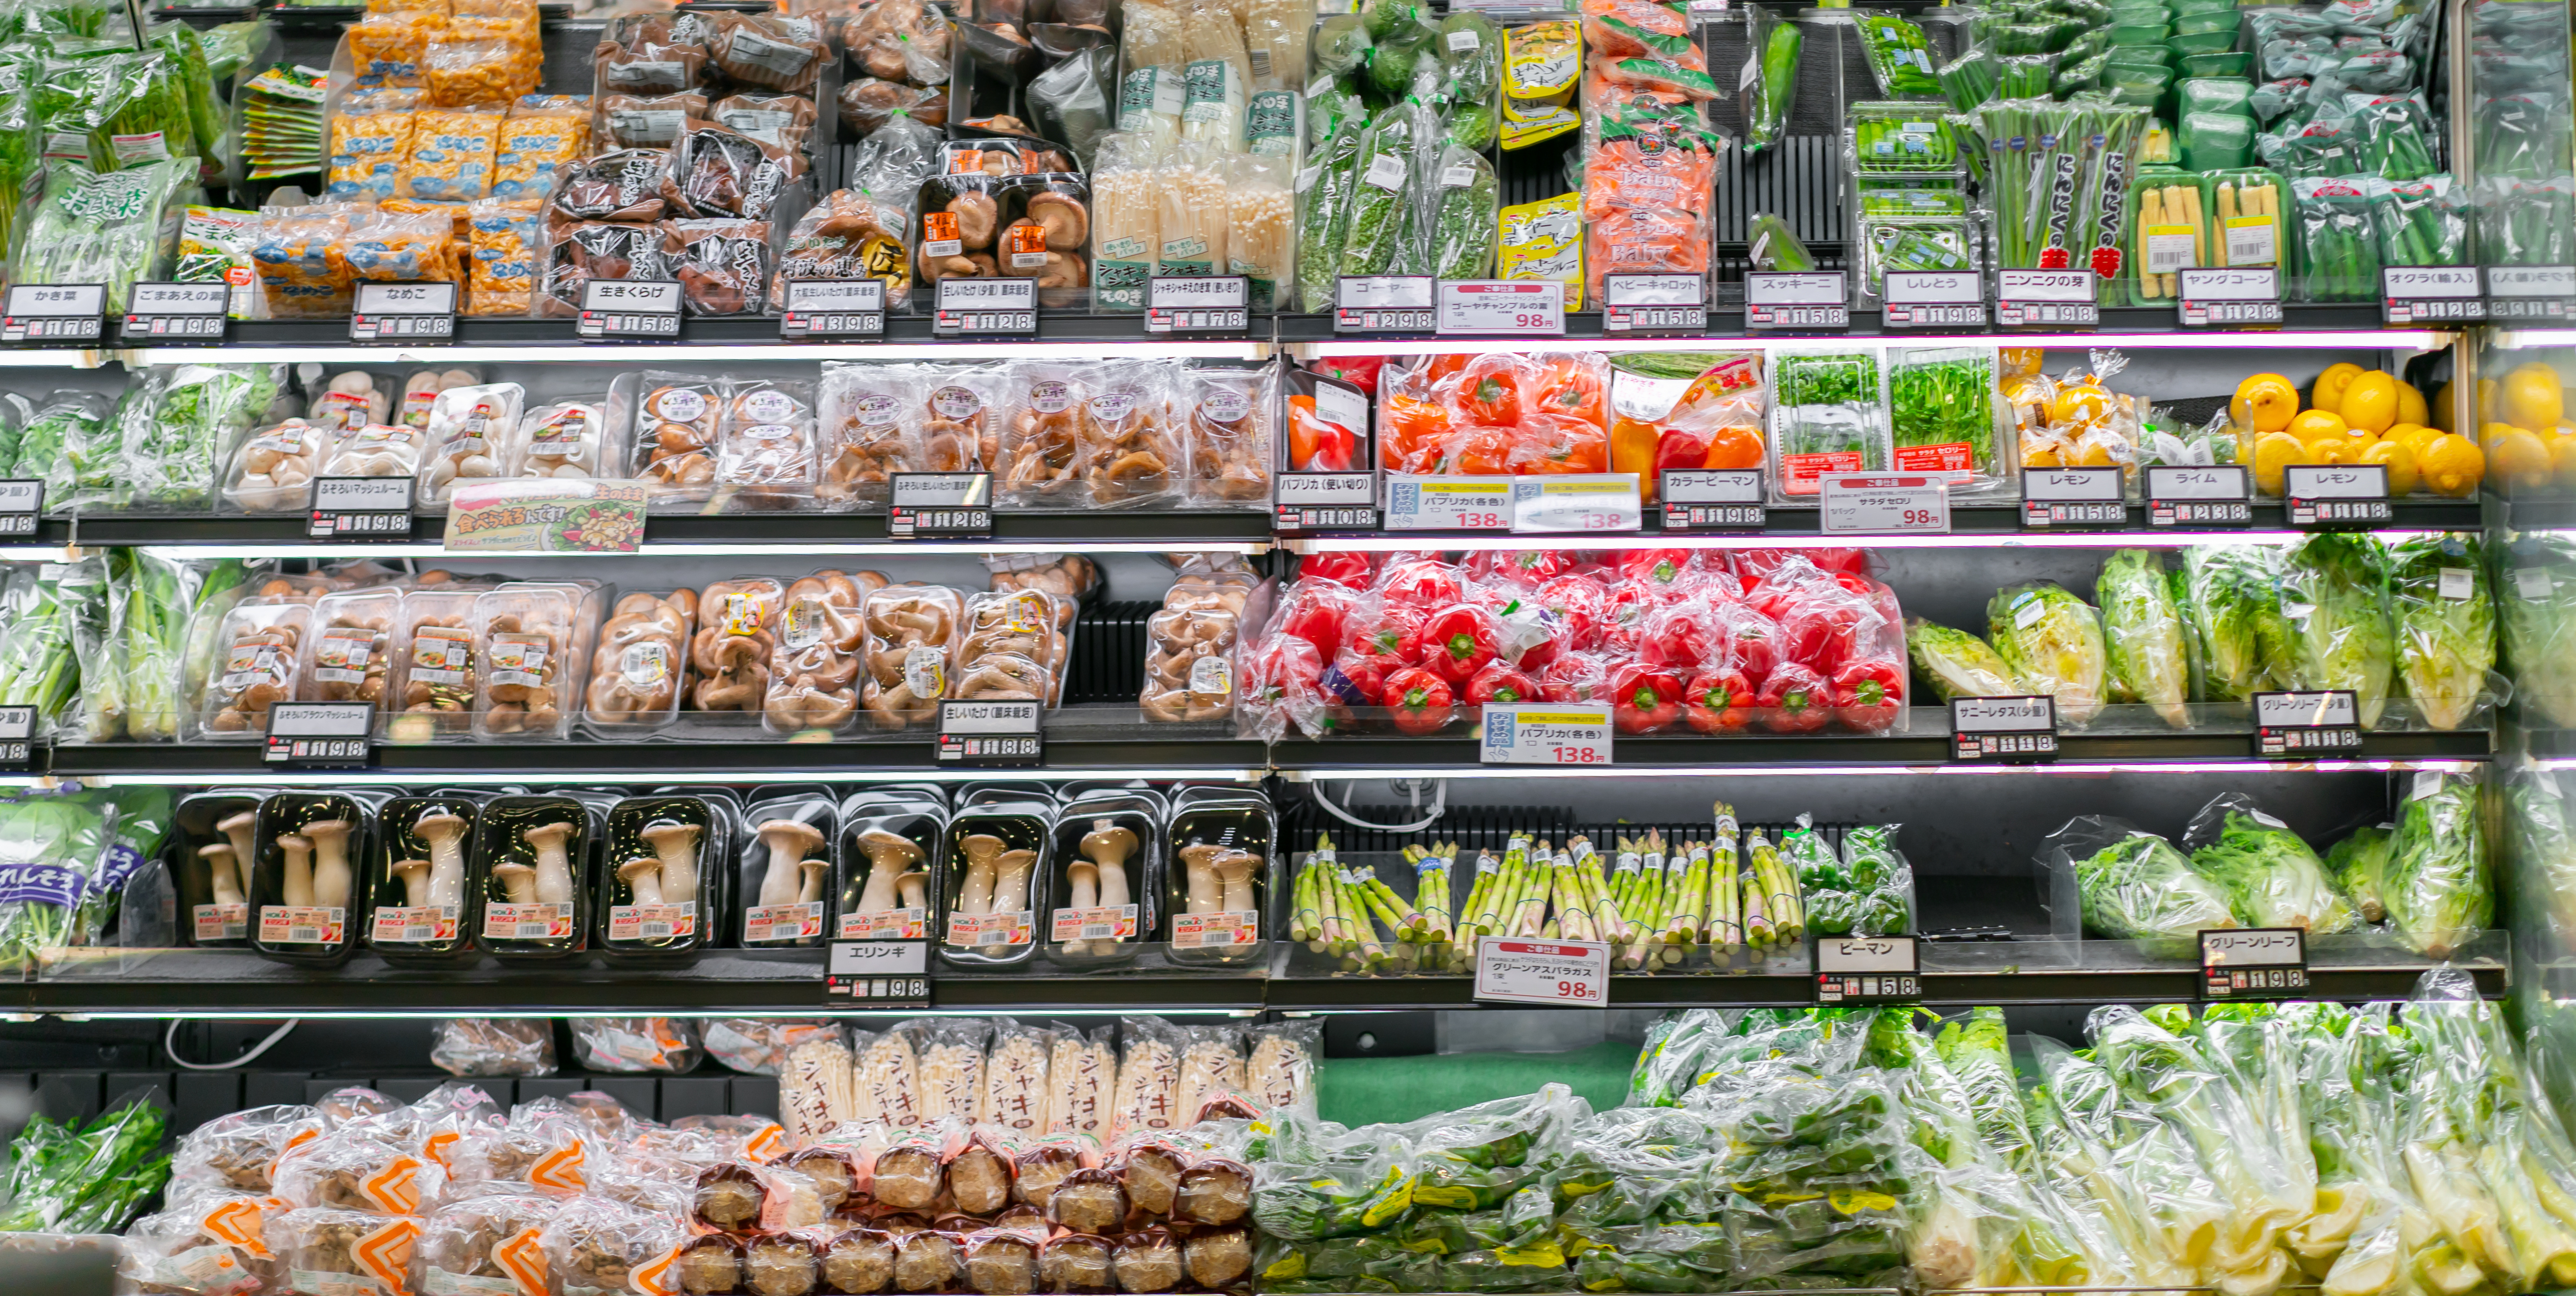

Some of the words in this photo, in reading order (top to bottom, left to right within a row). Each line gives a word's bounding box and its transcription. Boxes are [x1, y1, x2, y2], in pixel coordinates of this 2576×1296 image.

[1622, 171, 1683, 191] Baby
[1598, 223, 1686, 237] ベビーキャロット
[1609, 242, 1672, 266] Baby
[1613, 279, 1697, 290] ベビーキャロット
[1763, 278, 1831, 289] ズッキーニ
[1907, 278, 1957, 289] ししとう
[2005, 275, 2085, 287] ニンニクの芽
[2188, 275, 2271, 286] ヤングコーン
[34, 291, 77, 301] かき菜
[140, 290, 224, 302] ごまあえの素
[387, 288, 426, 300] なめこ
[600, 285, 664, 299] 生きくらげ
[1797, 310, 1840, 324] 158
[1934, 309, 1979, 323] 198
[2062, 307, 2091, 321] 98
[2228, 306, 2274, 320] 128
[2432, 303, 2482, 317] 128
[626, 316, 675, 332] 158
[830, 315, 876, 331] 398
[980, 314, 1029, 330] 128
[1214, 313, 1240, 327] 78
[1382, 313, 1431, 328] 298
[1654, 311, 1700, 325] 158
[46, 320, 93, 335] 178
[189, 320, 216, 334] 98
[417, 318, 445, 335] 98
[1670, 476, 1755, 487] カラーピーマン
[2050, 474, 2091, 485] レモン
[2176, 472, 2217, 484] ライム
[2316, 473, 2358, 485] レモン
[1322, 510, 1367, 524] 108
[1711, 509, 1757, 523] 198
[2071, 506, 2120, 521] 158
[2195, 505, 2242, 519] 238
[2340, 503, 2386, 518] 118
[355, 514, 403, 530] 198
[937, 513, 984, 528] 128
[1520, 729, 1602, 739] パプリカ(各色)
[2308, 731, 2356, 746] 118
[315, 742, 361, 757] 198
[985, 739, 1035, 754] 188
[2003, 735, 2051, 750] 118
[1840, 942, 1894, 956] ピーマン
[2211, 936, 2295, 949] グリーンリーフ
[850, 946, 906, 958] エリンギ
[1492, 963, 1592, 977] グリーンアスパラガス
[2255, 971, 2300, 986] 198
[893, 980, 924, 996] 98
[1885, 979, 1913, 994] 58
